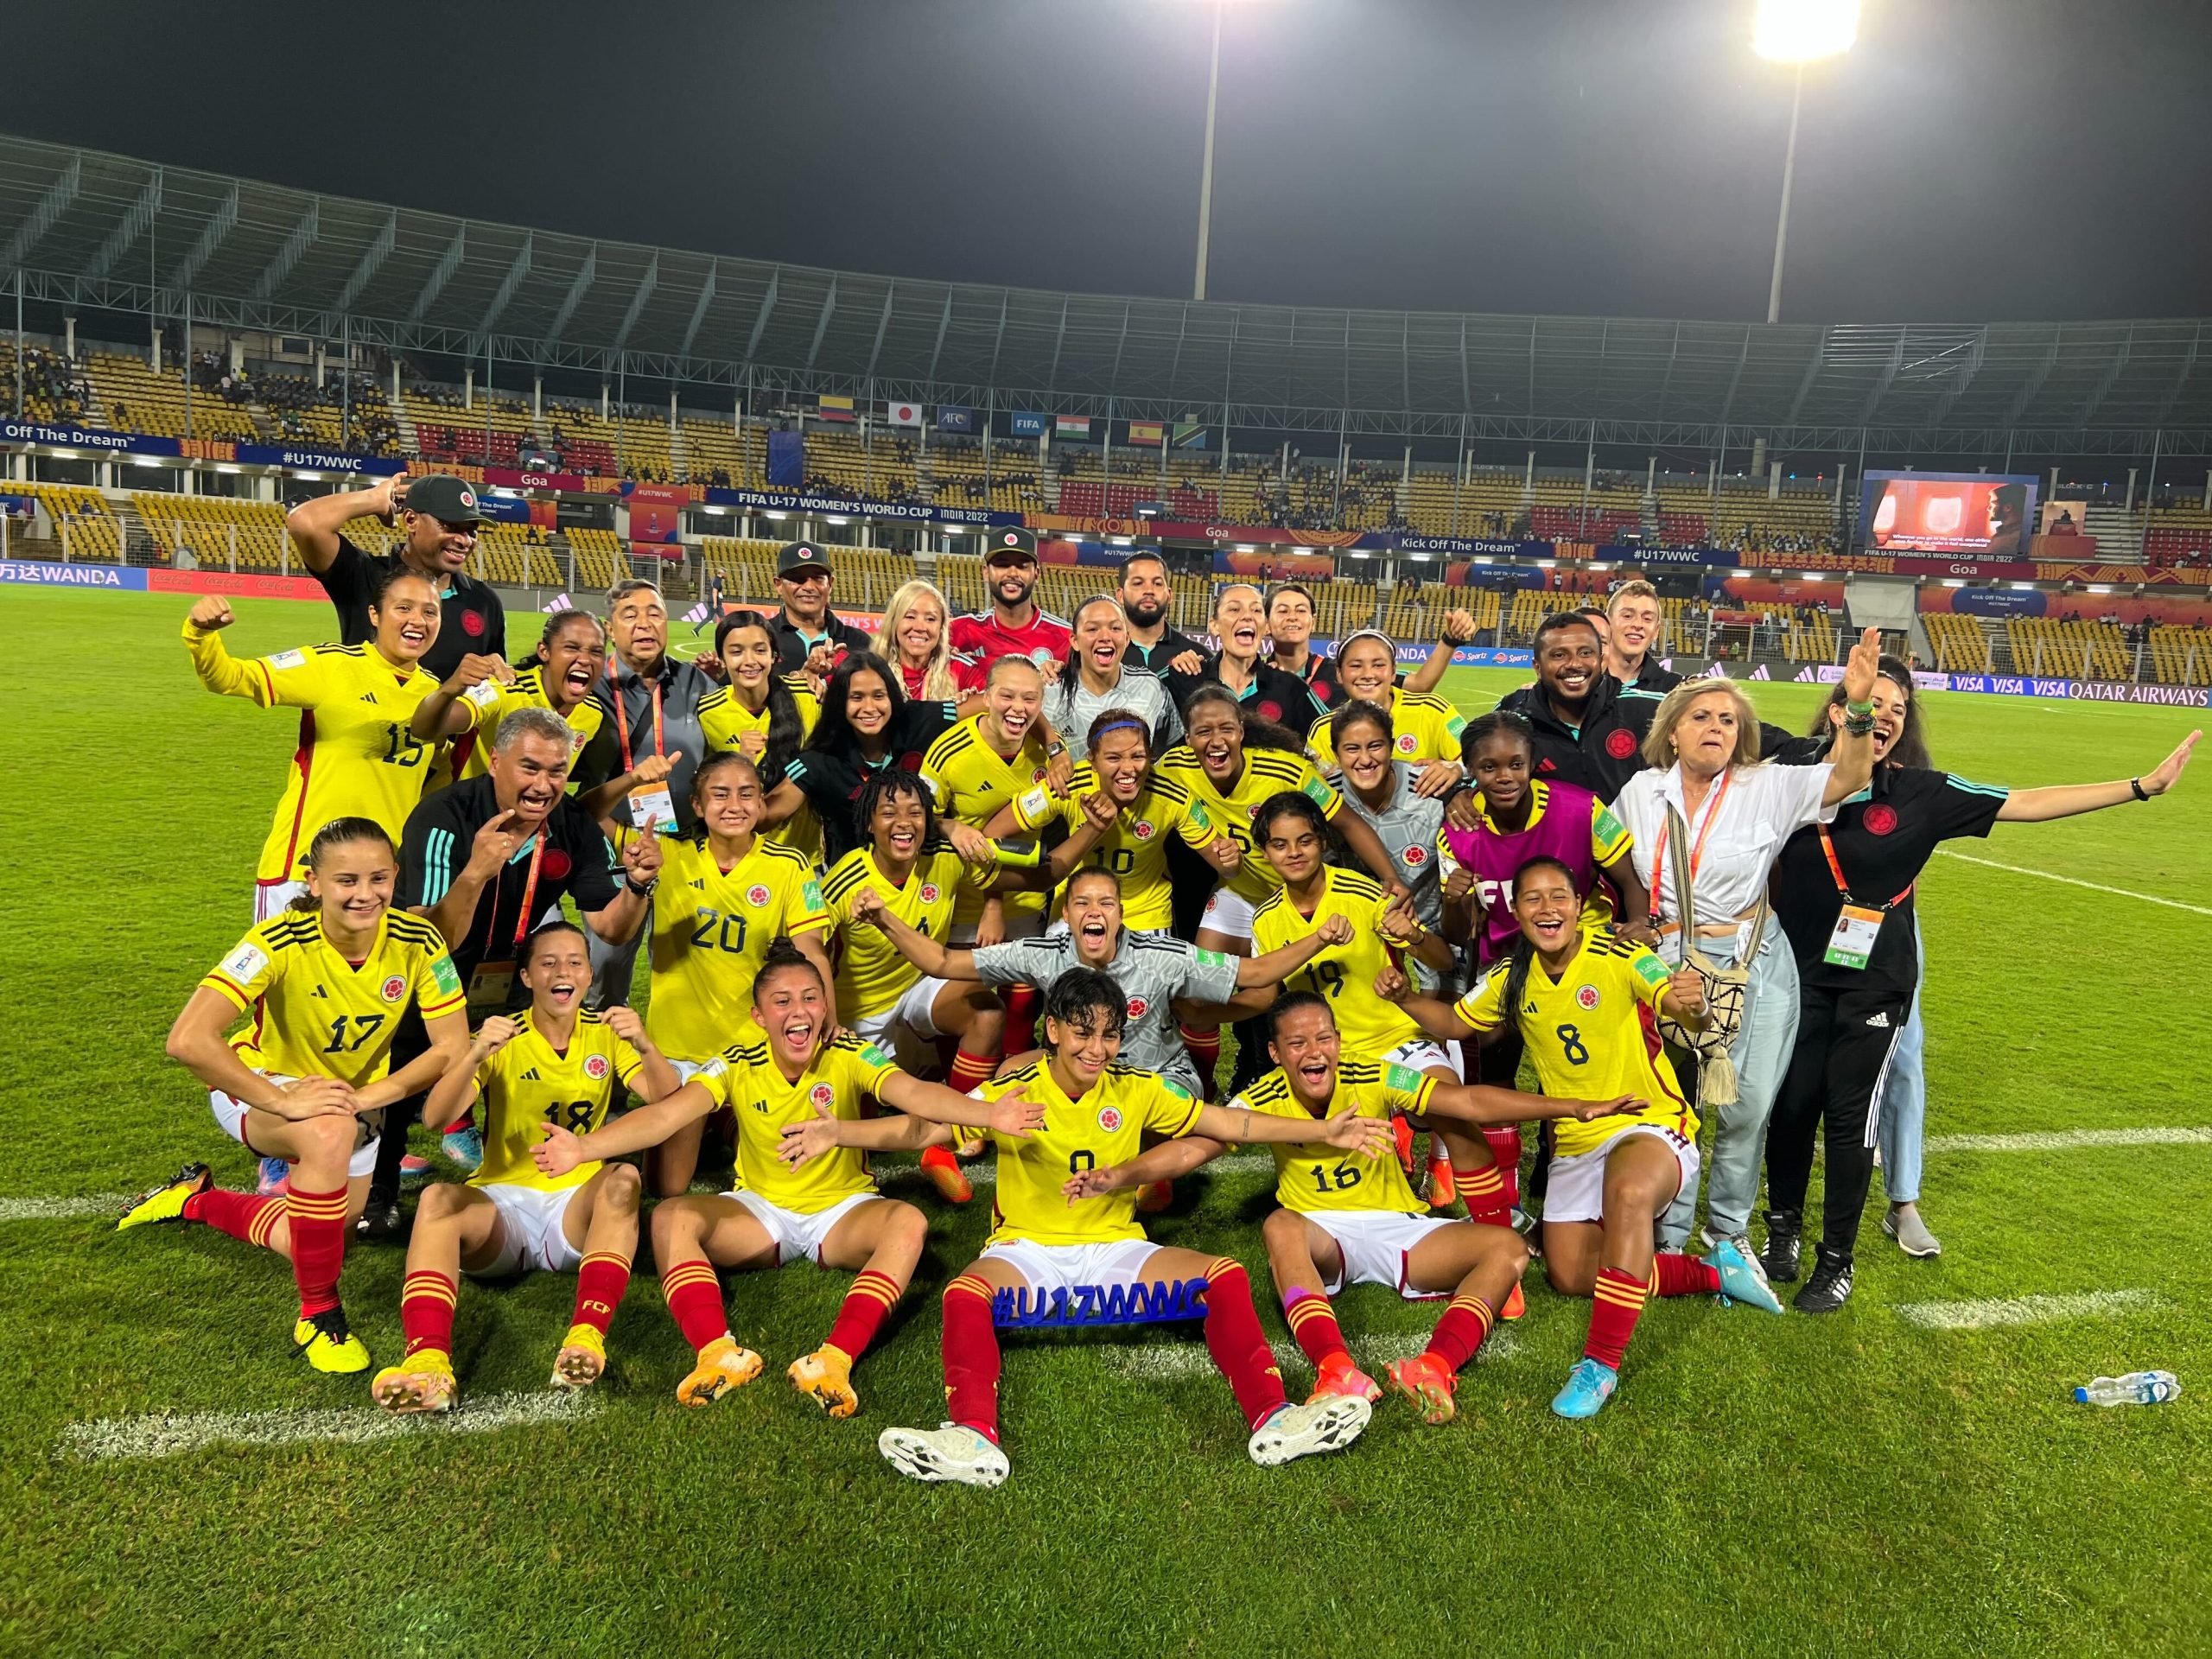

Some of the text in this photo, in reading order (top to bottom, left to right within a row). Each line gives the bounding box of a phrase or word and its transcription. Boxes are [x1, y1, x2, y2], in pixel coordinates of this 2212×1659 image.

[1017, 419, 1039, 429] FIFA
[5, 425, 33, 438] Off
[36, 428, 67, 442] The
[283, 452, 362, 470] #U17WWC
[521, 474, 548, 486] Goa
[638, 489, 673, 498] #U17WWC
[739, 493, 767, 505] FIFA
[769, 495, 797, 506] U-17
[799, 498, 861, 512] WOMEN'S
[862, 503, 906, 516] WORLD
[909, 507, 933, 518] CUP
[941, 509, 964, 520] INDIA
[1205, 527, 1229, 537] Goa
[1402, 537, 1426, 548] Kick
[1429, 539, 1448, 550] Off
[1451, 540, 1471, 550] The
[1633, 549, 1700, 562] #U17WWC
[41, 566, 120, 586] WANDA
[1950, 563, 1978, 575] Goa
[204, 575, 245, 589] Coca-Cola
[256, 578, 296, 593] Coca-Cola
[1466, 652, 1487, 661] Sportz
[1508, 654, 1529, 663] Sportz
[1955, 677, 1984, 691] VISA
[1991, 678, 2024, 695] VISA
[2031, 680, 2066, 696] VISA
[2069, 682, 2209, 707] QATAR AIRWAYS
[383, 724, 423, 767] 15
[1093, 846, 1135, 874] 10
[690, 906, 747, 954] 20
[1304, 959, 1344, 998] 19
[1866, 1019, 1890, 1027] adidas
[322, 1014, 385, 1053] 17
[1555, 1023, 1590, 1065] 8
[543, 1100, 594, 1143] 18
[1310, 1158, 1363, 1192] 16
[993, 1277, 1210, 1327] #U17WWC
